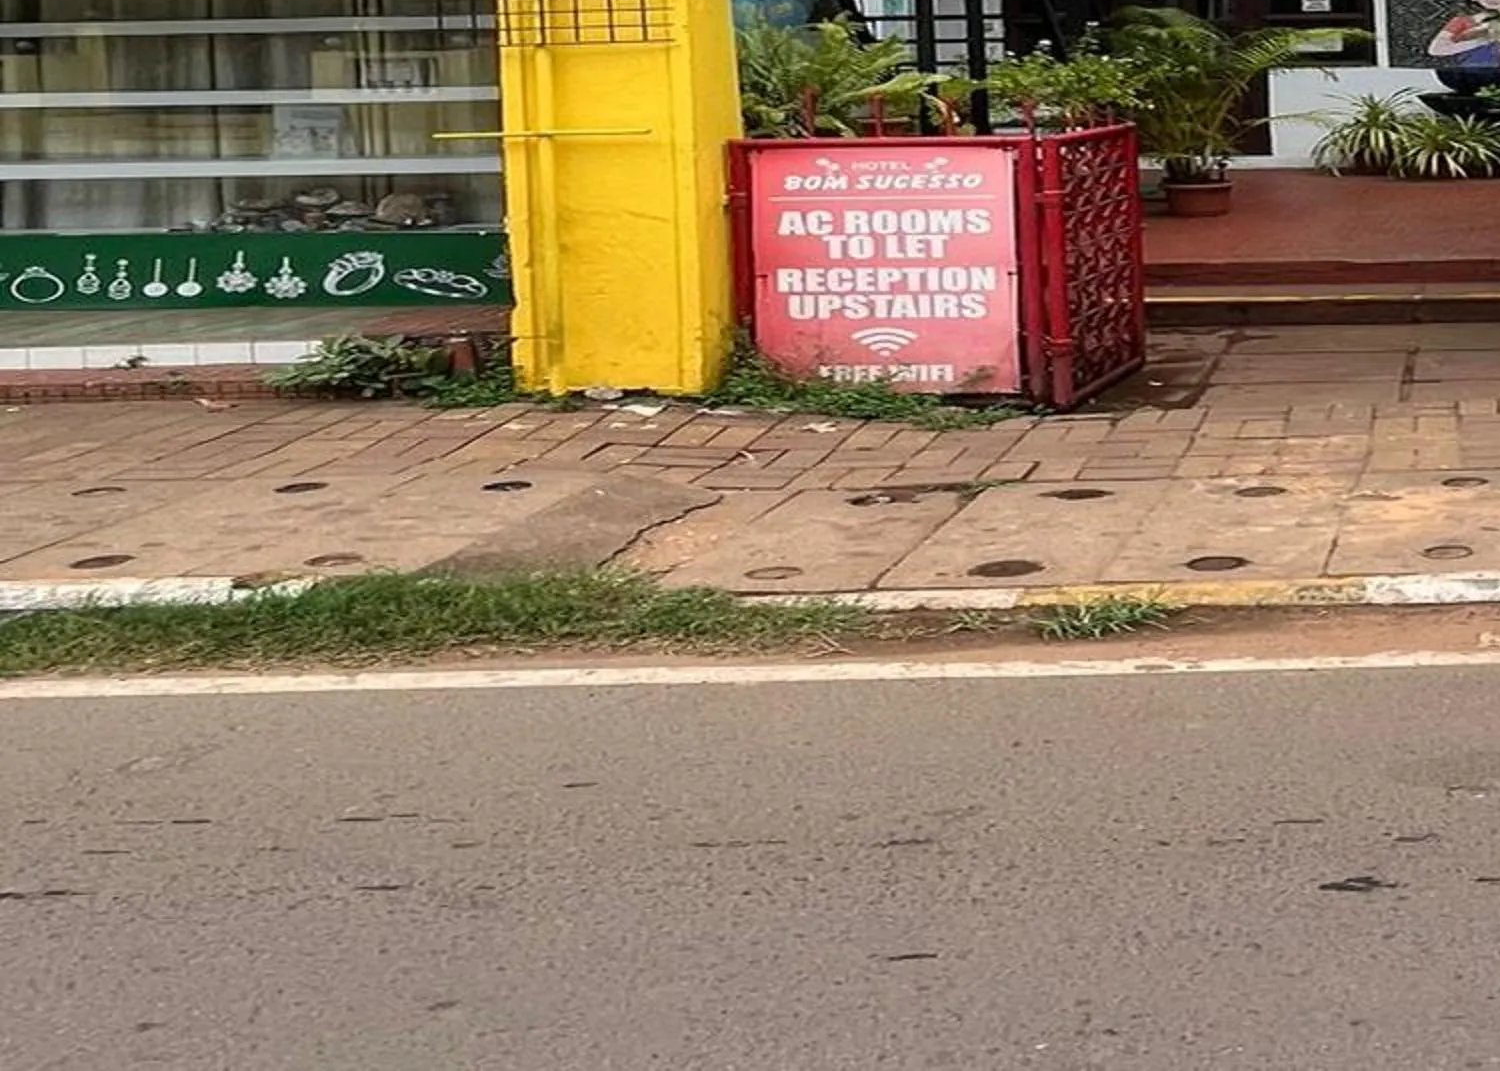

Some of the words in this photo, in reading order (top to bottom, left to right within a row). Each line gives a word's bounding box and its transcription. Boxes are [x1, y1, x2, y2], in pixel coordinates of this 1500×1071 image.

[851, 161, 911, 171] HOTEL
[784, 175, 848, 191] BOM
[855, 173, 983, 190] SUCESSO
[777, 210, 833, 235] AC
[844, 209, 992, 234] ROOMS
[823, 235, 875, 259] TO
[885, 234, 948, 259] LET
[776, 266, 996, 293] RECEPTION
[788, 293, 987, 319] UPSTAIRS
